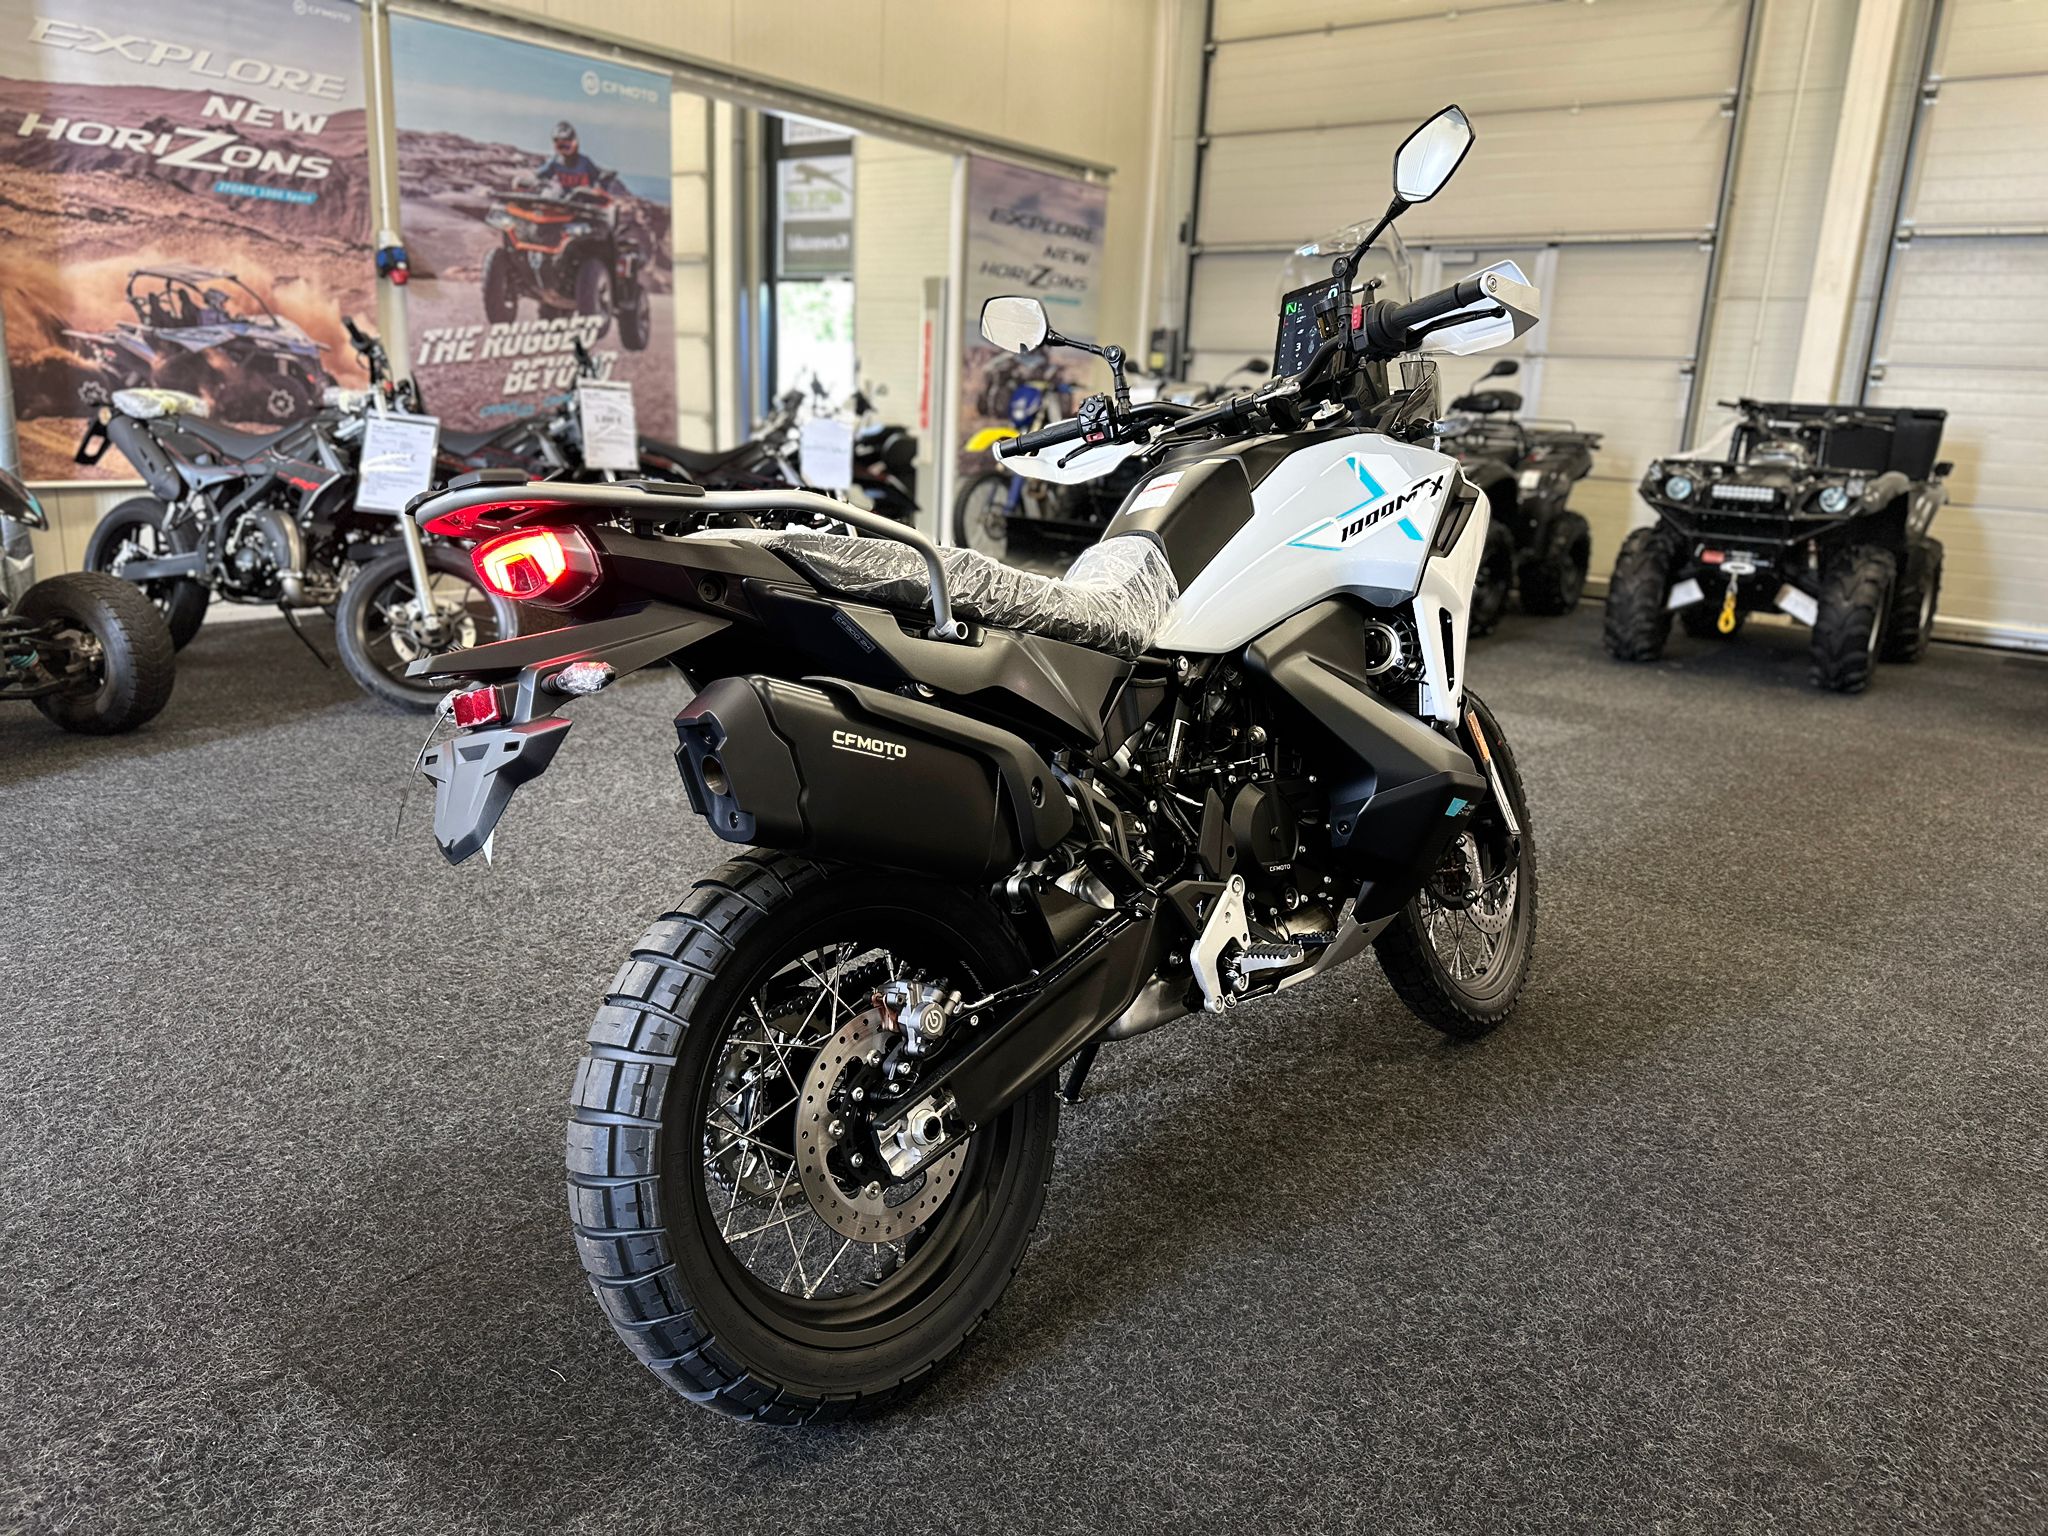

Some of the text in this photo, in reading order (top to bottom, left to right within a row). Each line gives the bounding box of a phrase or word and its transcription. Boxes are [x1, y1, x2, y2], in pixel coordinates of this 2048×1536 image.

[28, 16, 347, 100] EXPLORE
[601, 80, 658, 102] CFMOTO
[201, 95, 329, 136] NEW
[988, 207, 1095, 243] EXPLORE
[1043, 245, 1090, 265] NEW
[1286, 302, 1297, 315] N
[416, 313, 604, 366] THE RUGGED
[502, 351, 618, 396] BEYOD
[832, 730, 907, 758] CFMOTO
[1269, 863, 1291, 872] CFMOTO
